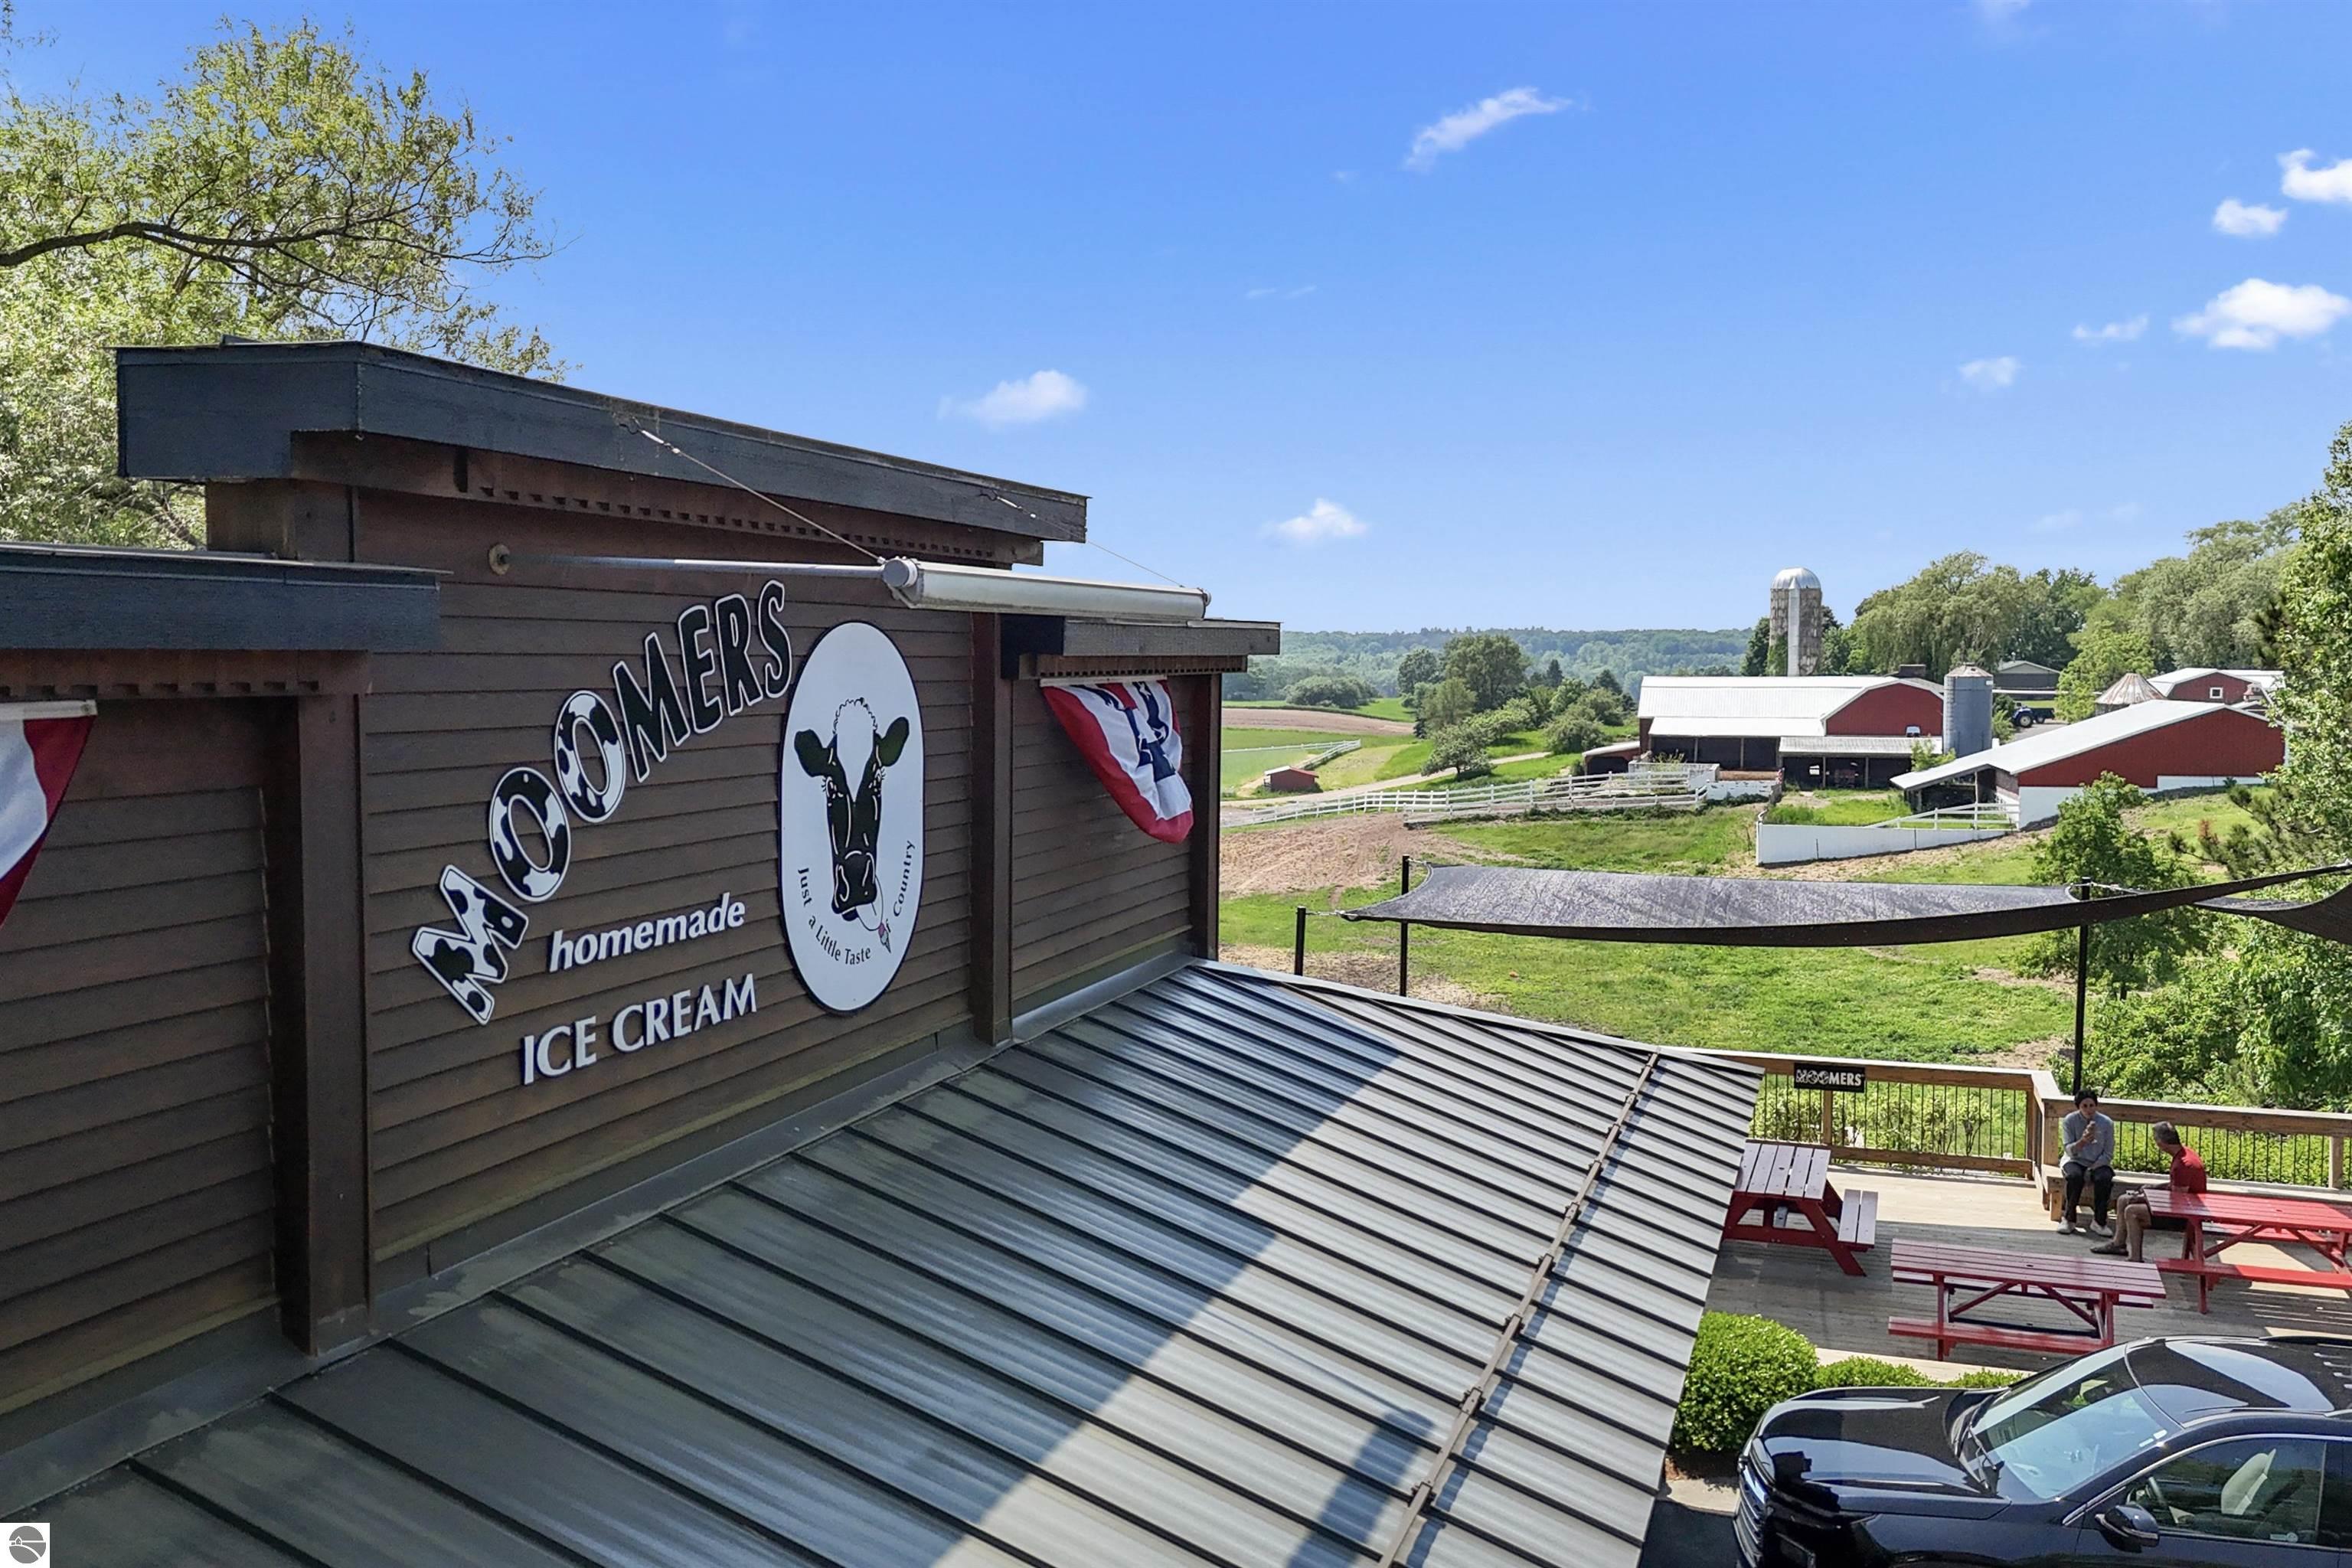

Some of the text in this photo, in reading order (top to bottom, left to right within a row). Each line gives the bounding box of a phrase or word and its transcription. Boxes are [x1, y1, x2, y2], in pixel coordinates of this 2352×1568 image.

[411, 580, 793, 1025] MOOMERS
[549, 892, 746, 972] homemade
[798, 867, 812, 906] Just
[808, 916, 816, 929] a
[815, 925, 841, 961] Little
[844, 947, 871, 965] Taste
[893, 840, 916, 916] Country
[520, 973, 757, 1085] ICE CREAM
[1795, 1070, 1861, 1086] MOOMERS
